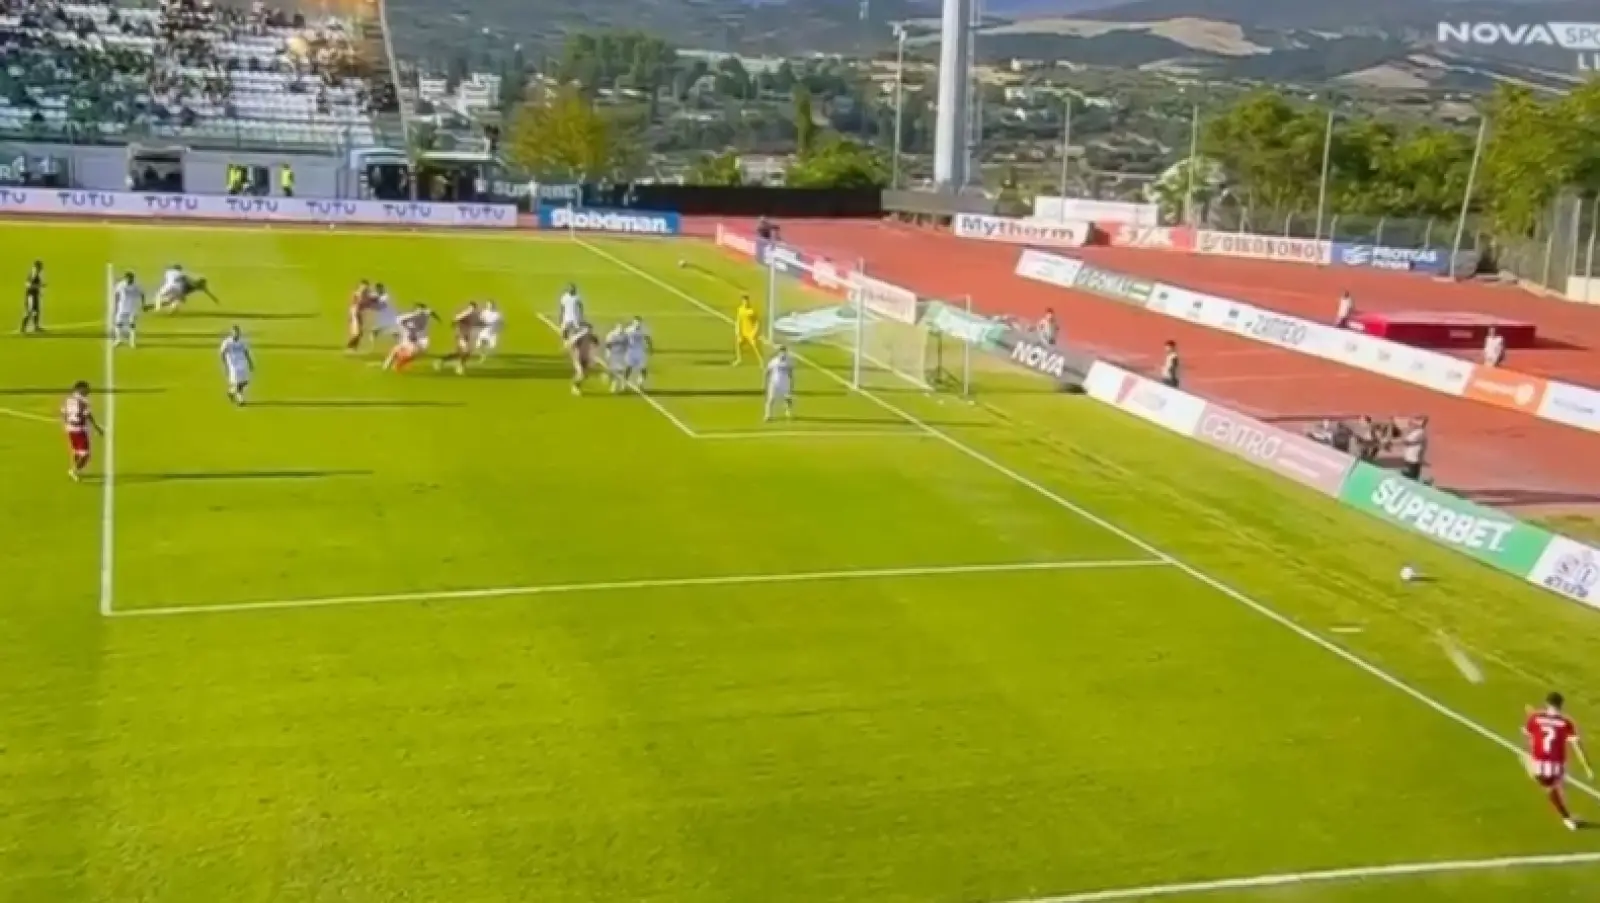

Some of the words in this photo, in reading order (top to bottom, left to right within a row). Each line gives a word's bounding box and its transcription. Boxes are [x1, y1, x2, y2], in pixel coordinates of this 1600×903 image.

[57, 192, 115, 207] TUTU
[144, 196, 198, 210] TUTU
[226, 199, 279, 212] TUTU
[306, 201, 357, 215] TUTU
[382, 203, 432, 218] TUTU
[457, 206, 505, 220] TUTU
[1011, 340, 1066, 378] NOVA
[1371, 477, 1512, 552] SUPERBET
[1541, 726, 1555, 753] 7
